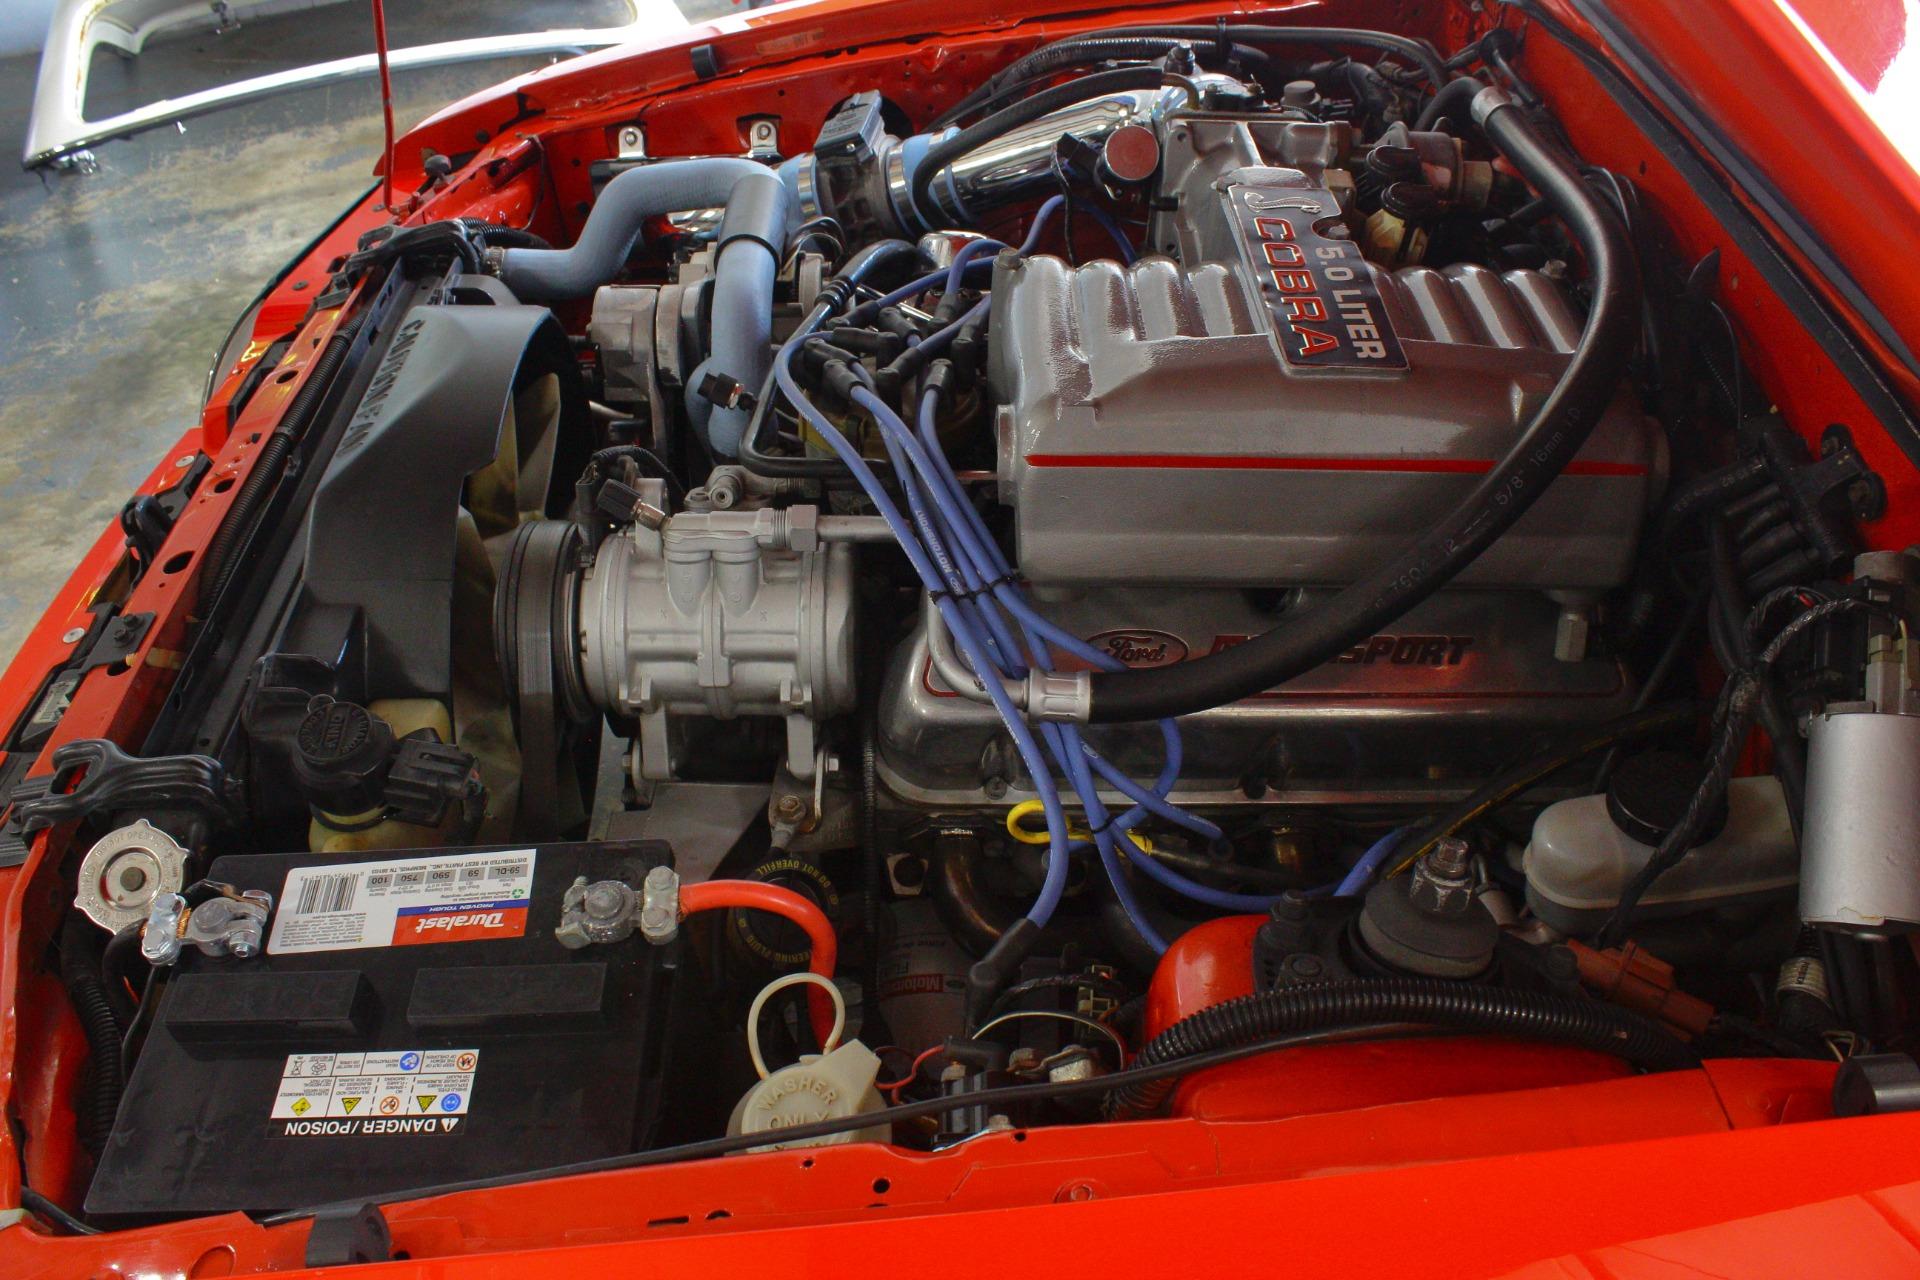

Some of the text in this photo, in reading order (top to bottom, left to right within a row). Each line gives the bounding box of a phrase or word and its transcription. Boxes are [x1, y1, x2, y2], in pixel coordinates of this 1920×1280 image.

[1254, 217, 1340, 358] COBRA
[1315, 246, 1388, 360] 5.0 LITER
[914, 508, 954, 574] MOTORSPORT
[1104, 634, 1168, 662] Ford
[401, 874, 418, 882] 750
[468, 869, 479, 877] 59
[495, 866, 520, 875] 59-DL
[754, 859, 800, 876] OVERFILL
[415, 912, 504, 933] Duralast
[757, 1075, 840, 1111] WASHER
[363, 1119, 437, 1134] DANGER
